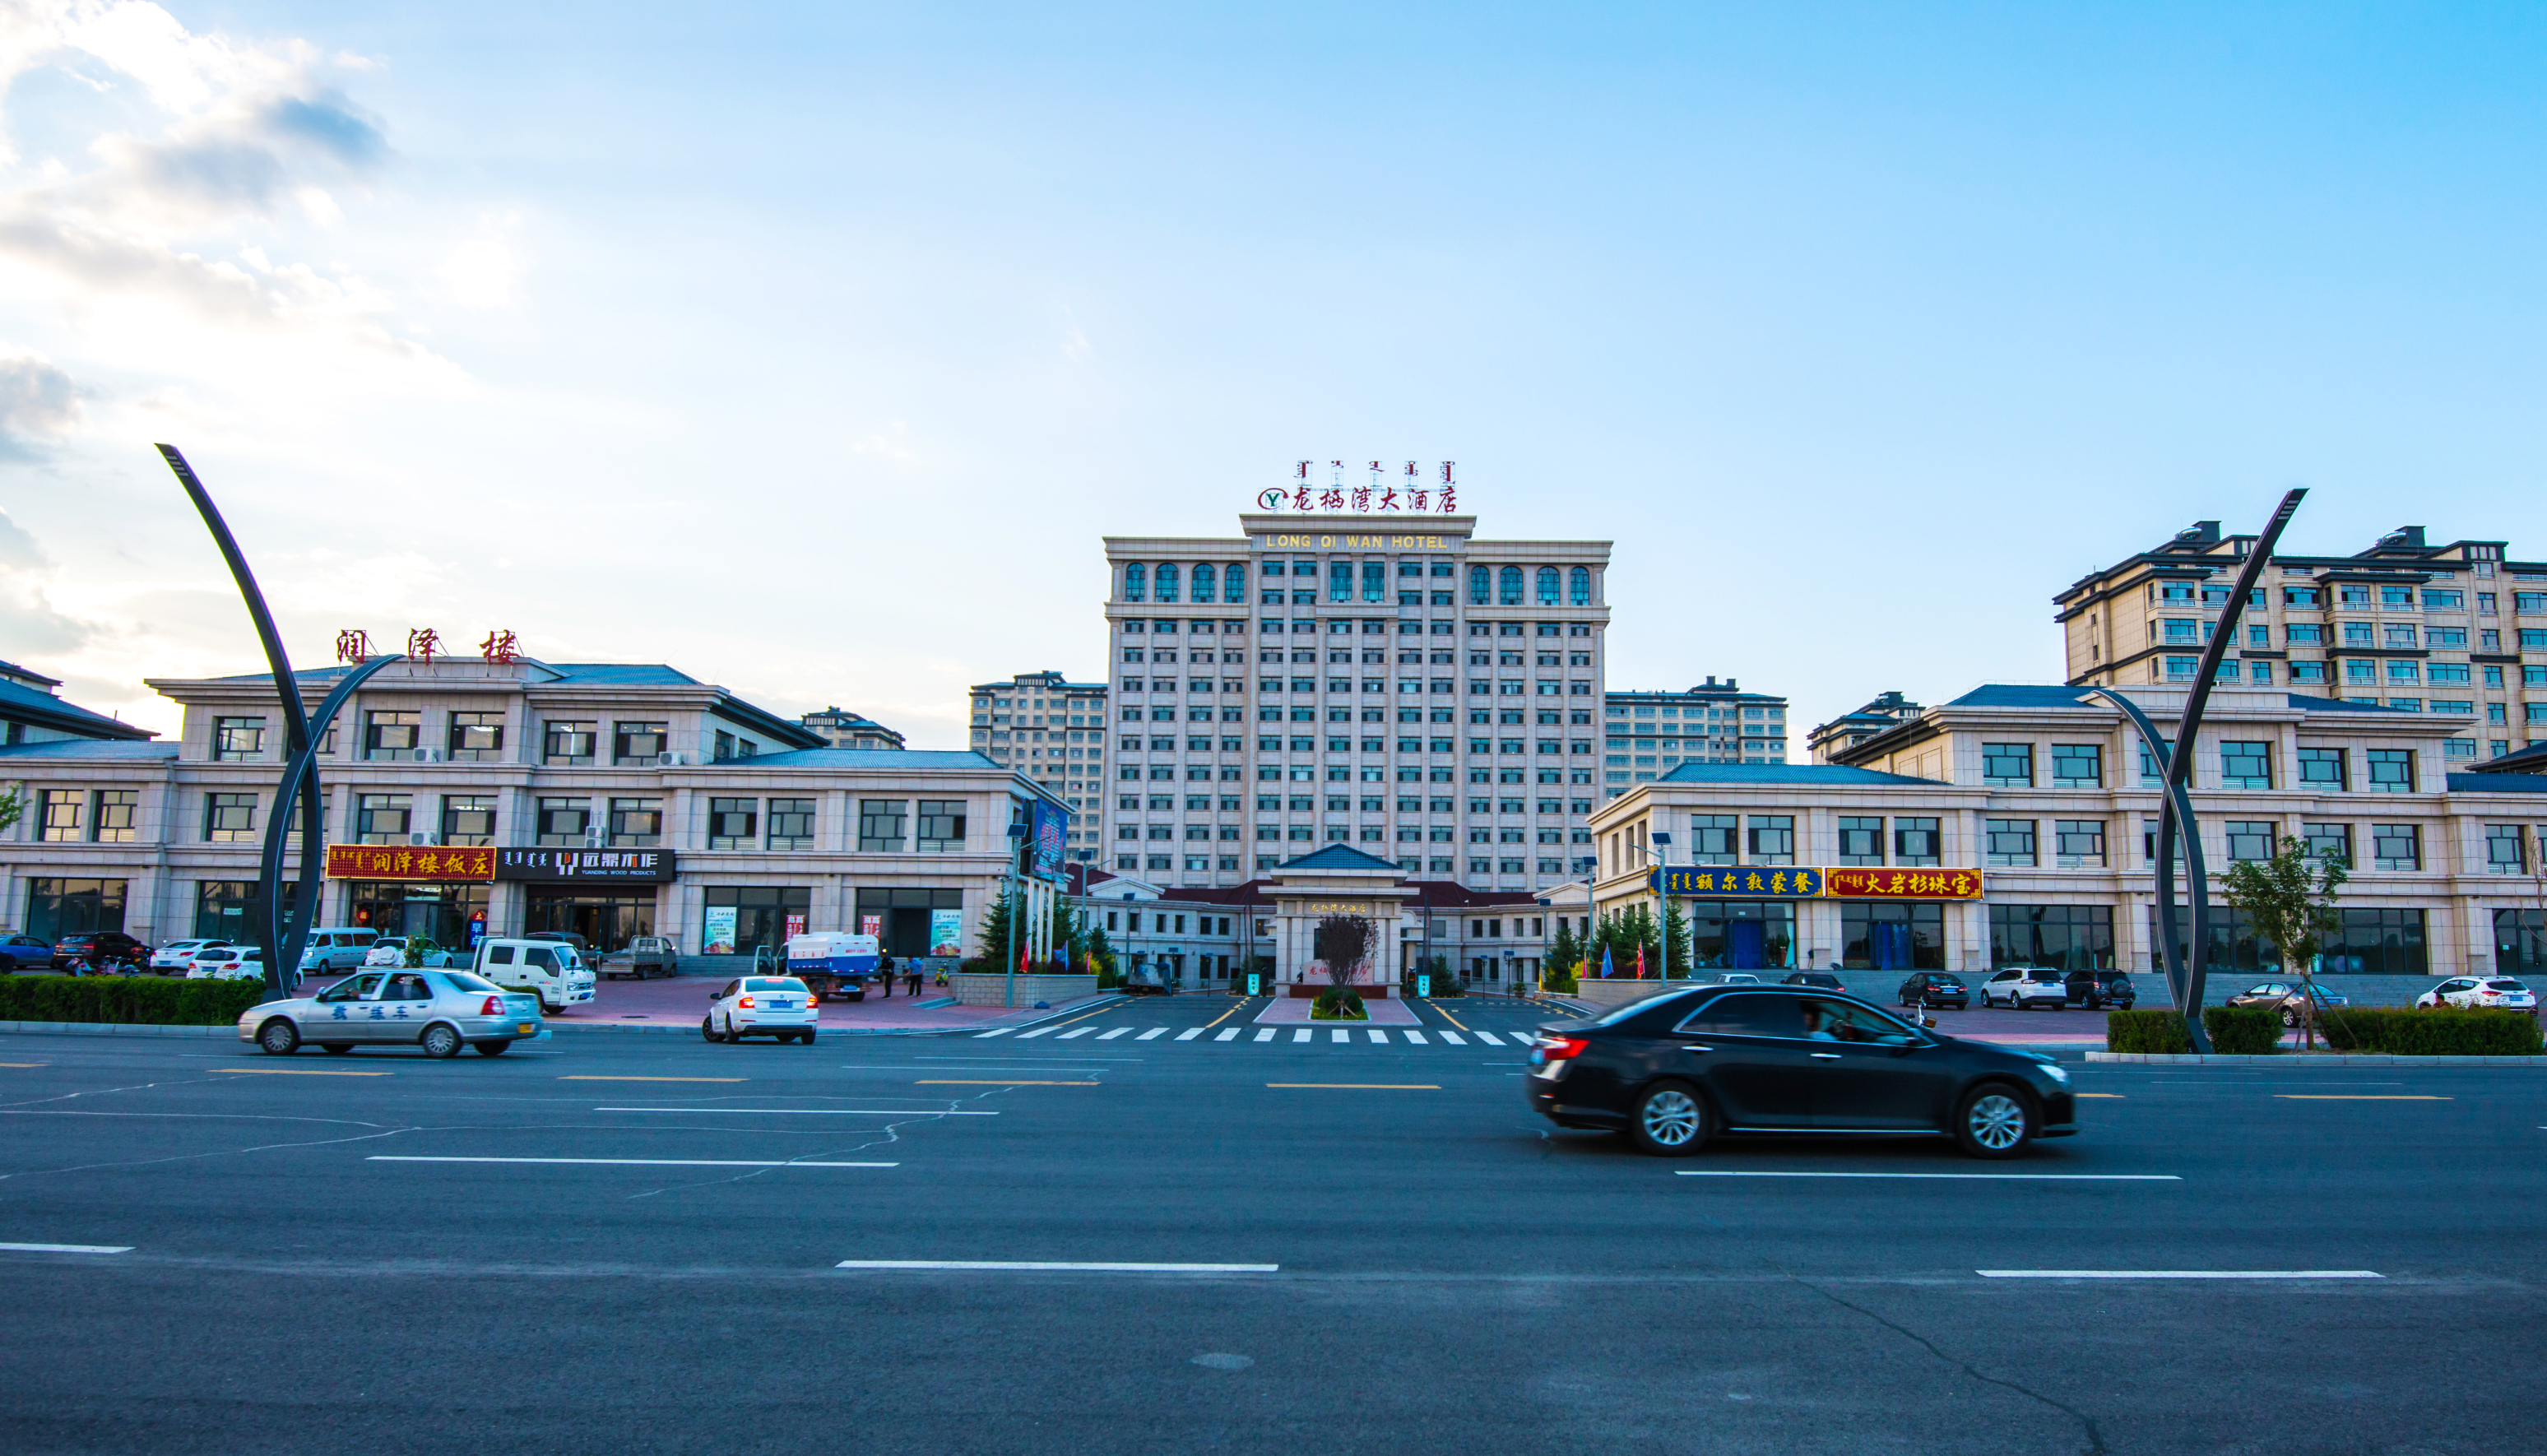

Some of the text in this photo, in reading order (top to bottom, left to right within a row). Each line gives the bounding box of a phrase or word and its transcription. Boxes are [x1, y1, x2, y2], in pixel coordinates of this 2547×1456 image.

[1293, 486, 1456, 513] 龙栖湾大酒店
[1267, 535, 1448, 549] LONG QI WAN HOTEL
[336, 628, 521, 666] 润泽楼
[373, 851, 490, 875] 润泽楼饭庄
[582, 852, 659, 868] 远鼎木作
[1695, 870, 1814, 894] 额尔敦蒙餐
